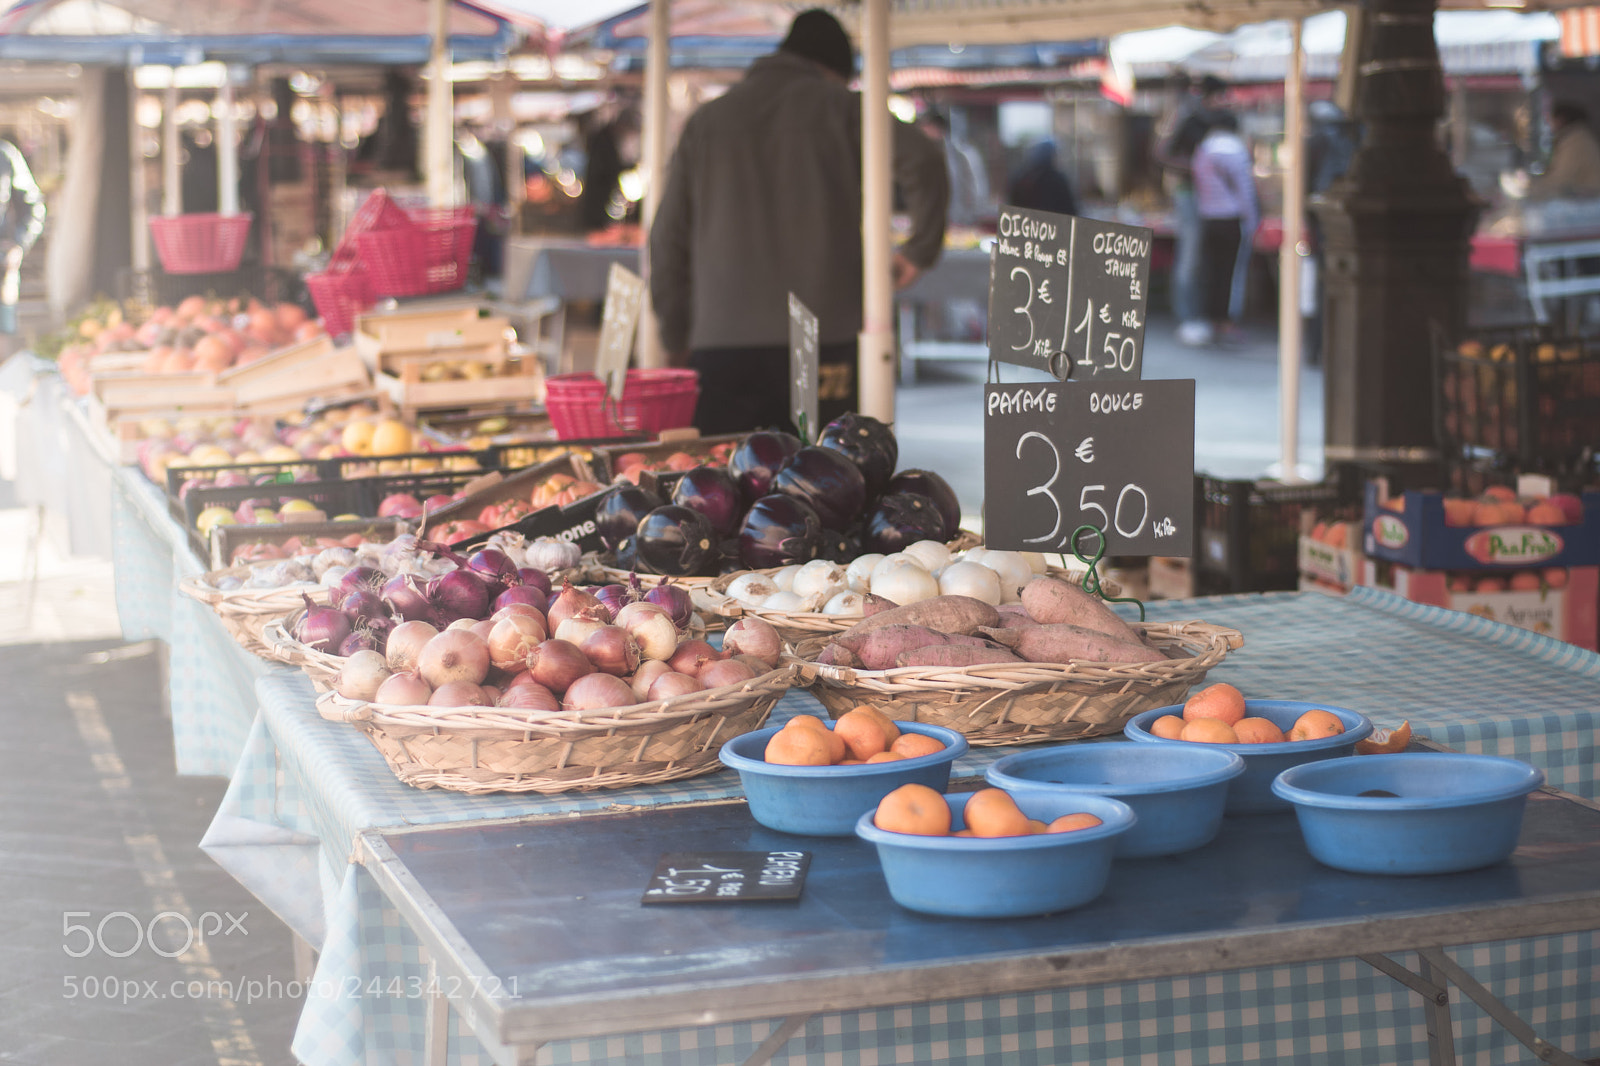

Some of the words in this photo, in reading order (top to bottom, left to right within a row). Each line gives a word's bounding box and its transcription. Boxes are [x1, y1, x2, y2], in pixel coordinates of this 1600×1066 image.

[1000, 213, 1056, 241] OIGNON
[1093, 232, 1148, 258] OIGNON
[1105, 258, 1138, 279] JAUNE
[1010, 266, 1034, 350] 3
[988, 388, 1057, 416] PATATE
[1090, 392, 1143, 414] DOUCE
